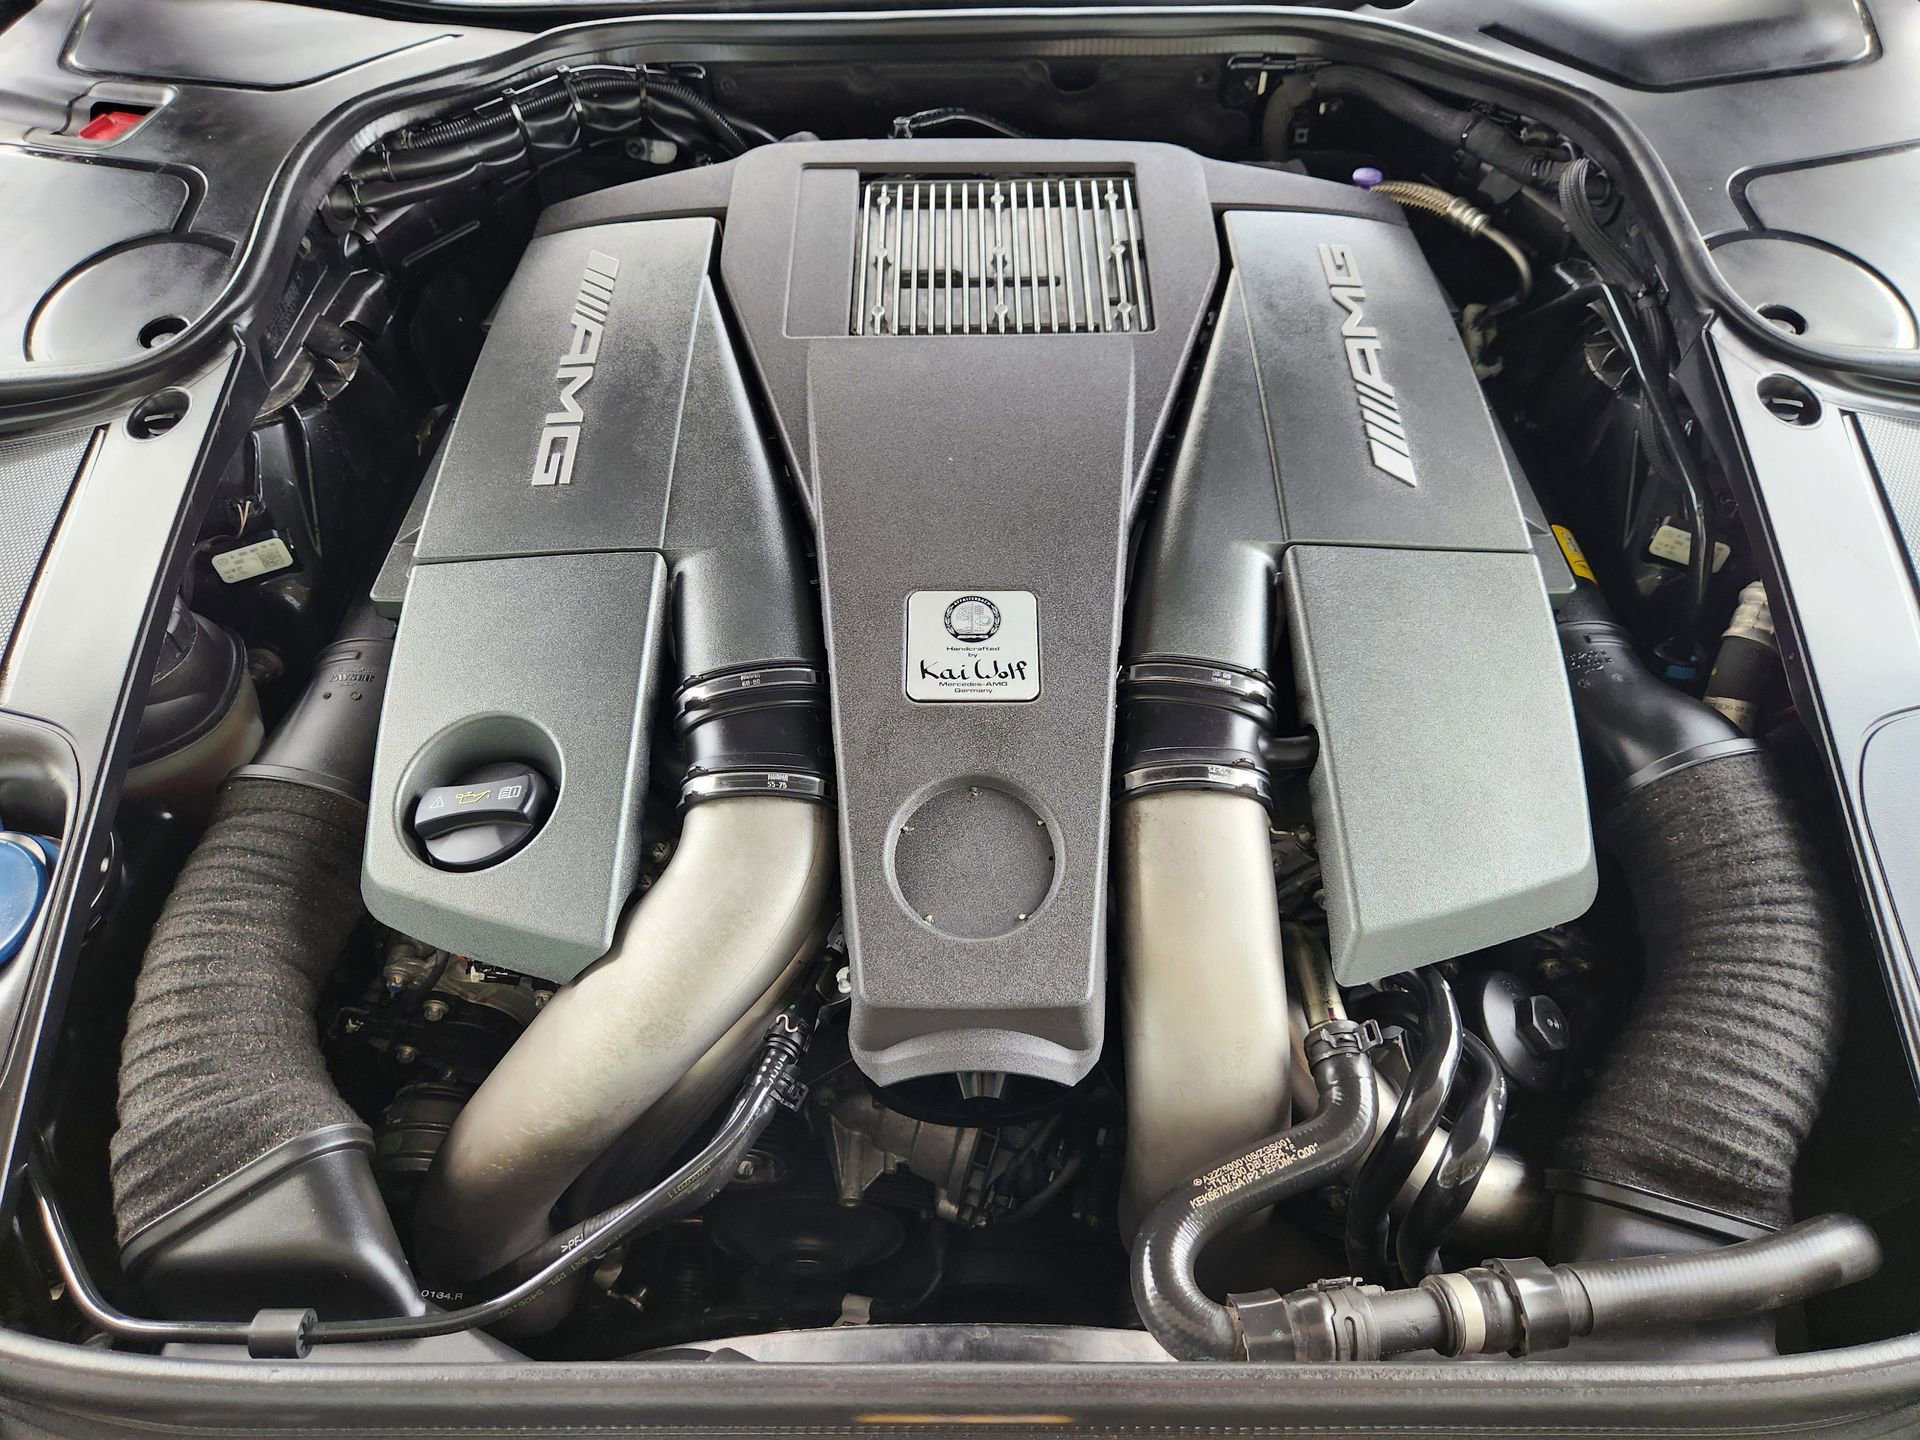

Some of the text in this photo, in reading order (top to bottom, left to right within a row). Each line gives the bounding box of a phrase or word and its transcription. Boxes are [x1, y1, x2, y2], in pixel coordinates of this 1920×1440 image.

[531, 312, 604, 486] AMG
[1318, 243, 1393, 399] AMG
[920, 659, 1027, 680] Kai Wolf
